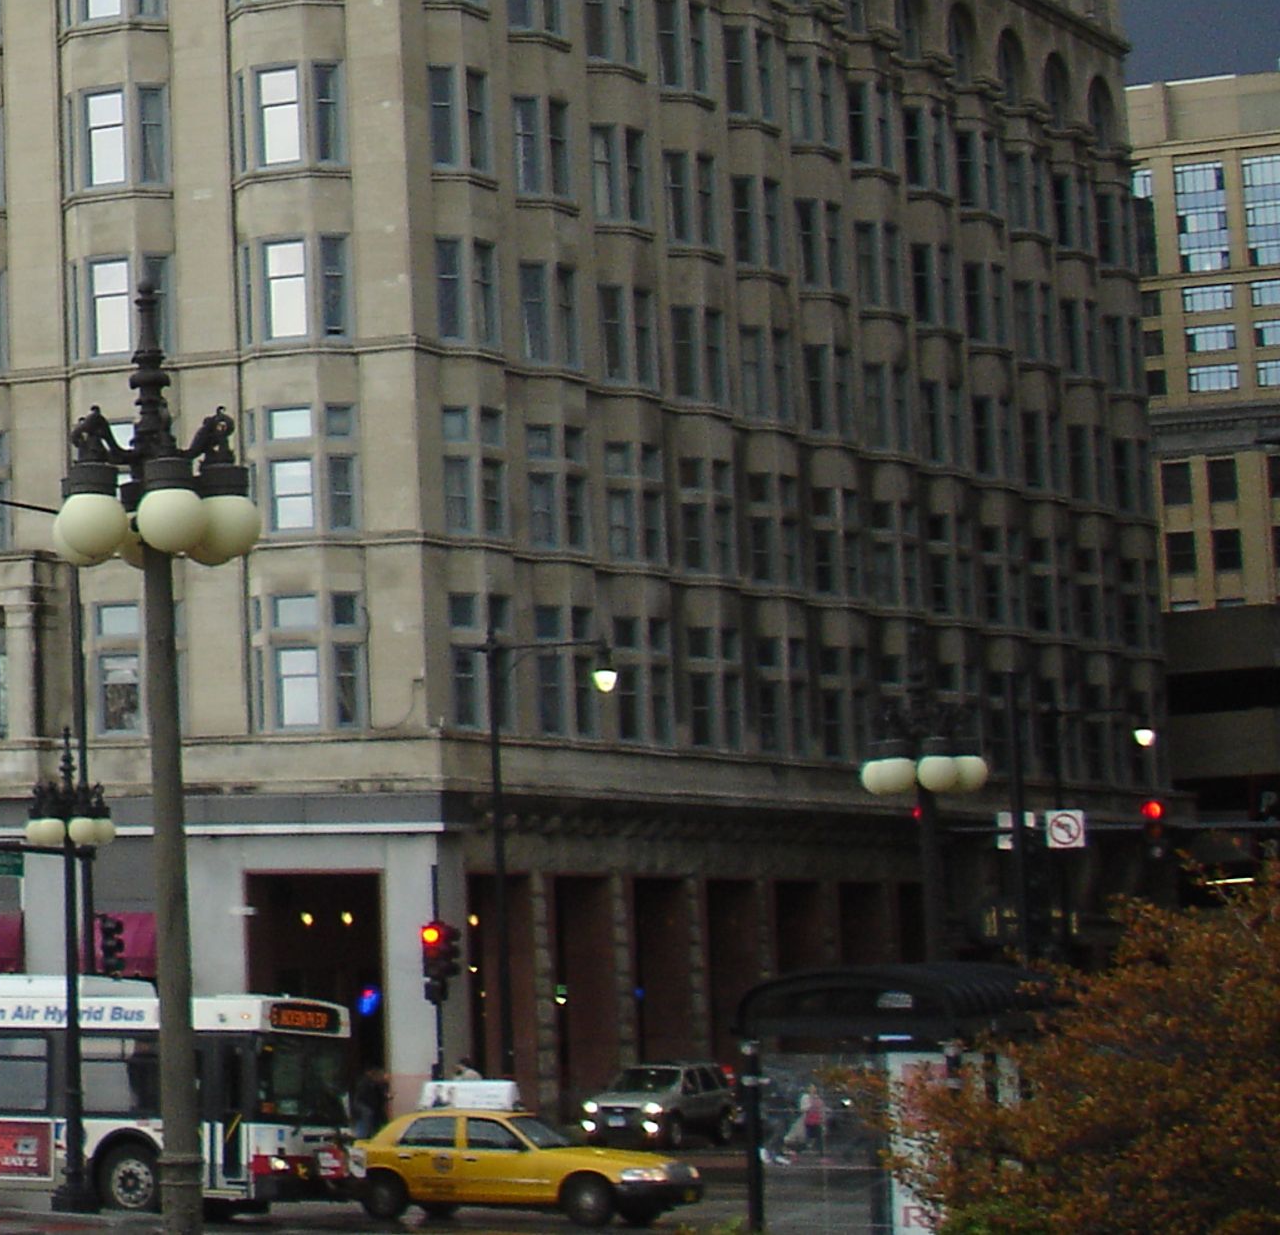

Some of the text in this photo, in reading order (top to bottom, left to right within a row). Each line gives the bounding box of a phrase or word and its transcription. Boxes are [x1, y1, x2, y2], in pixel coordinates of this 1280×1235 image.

[11, 1005, 39, 1021] Air
[43, 1005, 104, 1024] Hyrid
[108, 1006, 146, 1022] Bus
